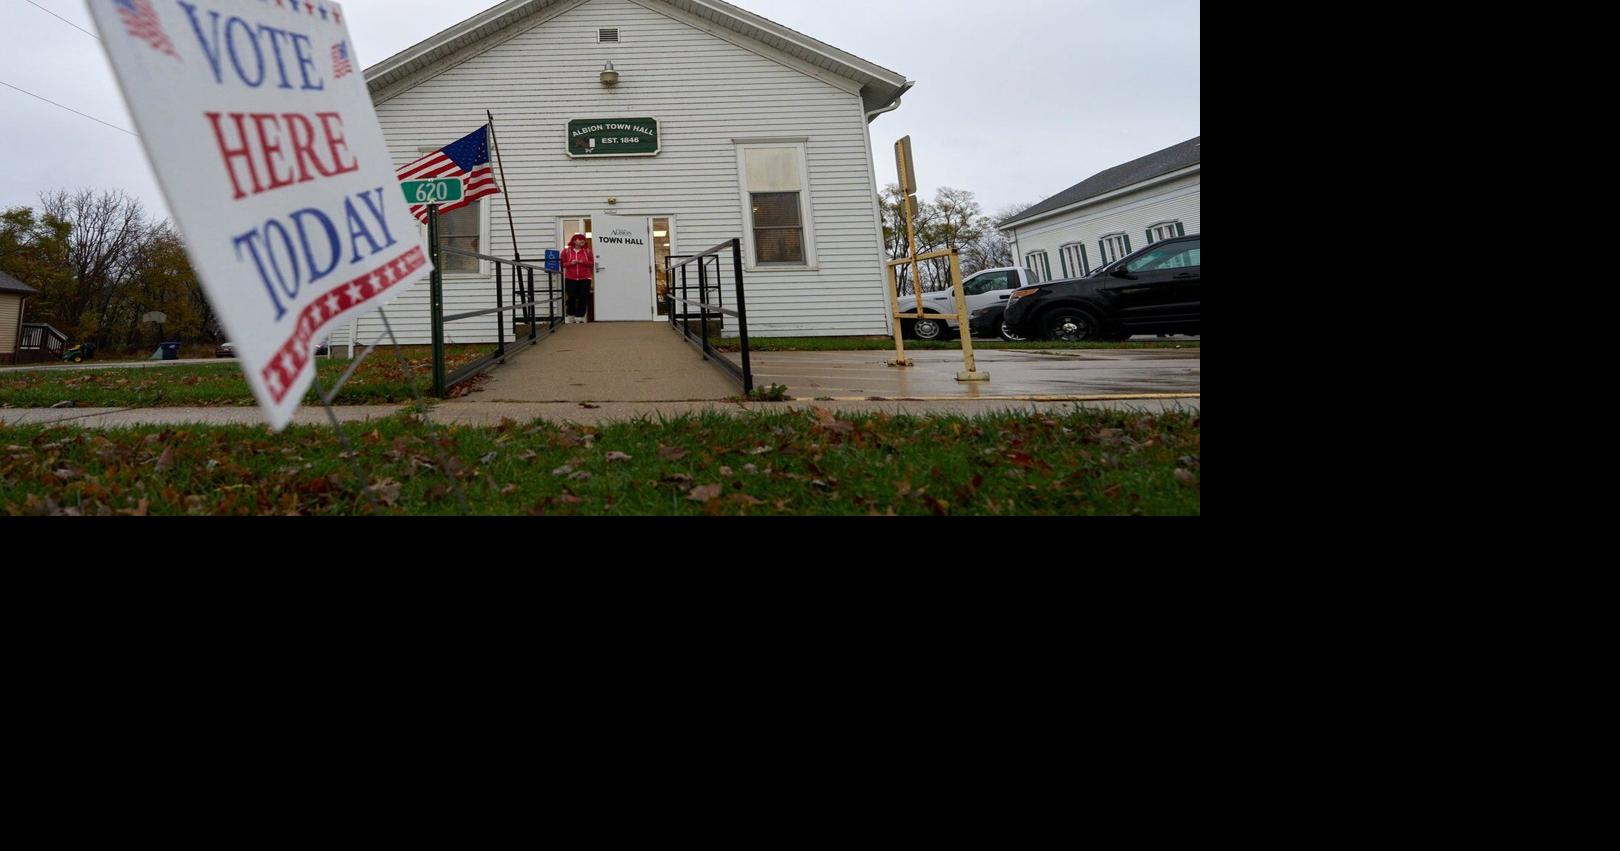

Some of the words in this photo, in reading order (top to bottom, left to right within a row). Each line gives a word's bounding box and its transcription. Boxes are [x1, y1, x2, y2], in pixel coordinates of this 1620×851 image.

[177, 0, 324, 91] VOTE
[572, 124, 603, 137] ALBION
[605, 123, 631, 131] TOWN
[632, 125, 654, 136] HALL
[620, 136, 640, 144] 1846
[205, 111, 358, 200] HERE
[415, 181, 448, 202] 620
[598, 236, 623, 244] TOWN
[624, 237, 644, 246] HALL
[232, 187, 397, 322] TODAY
